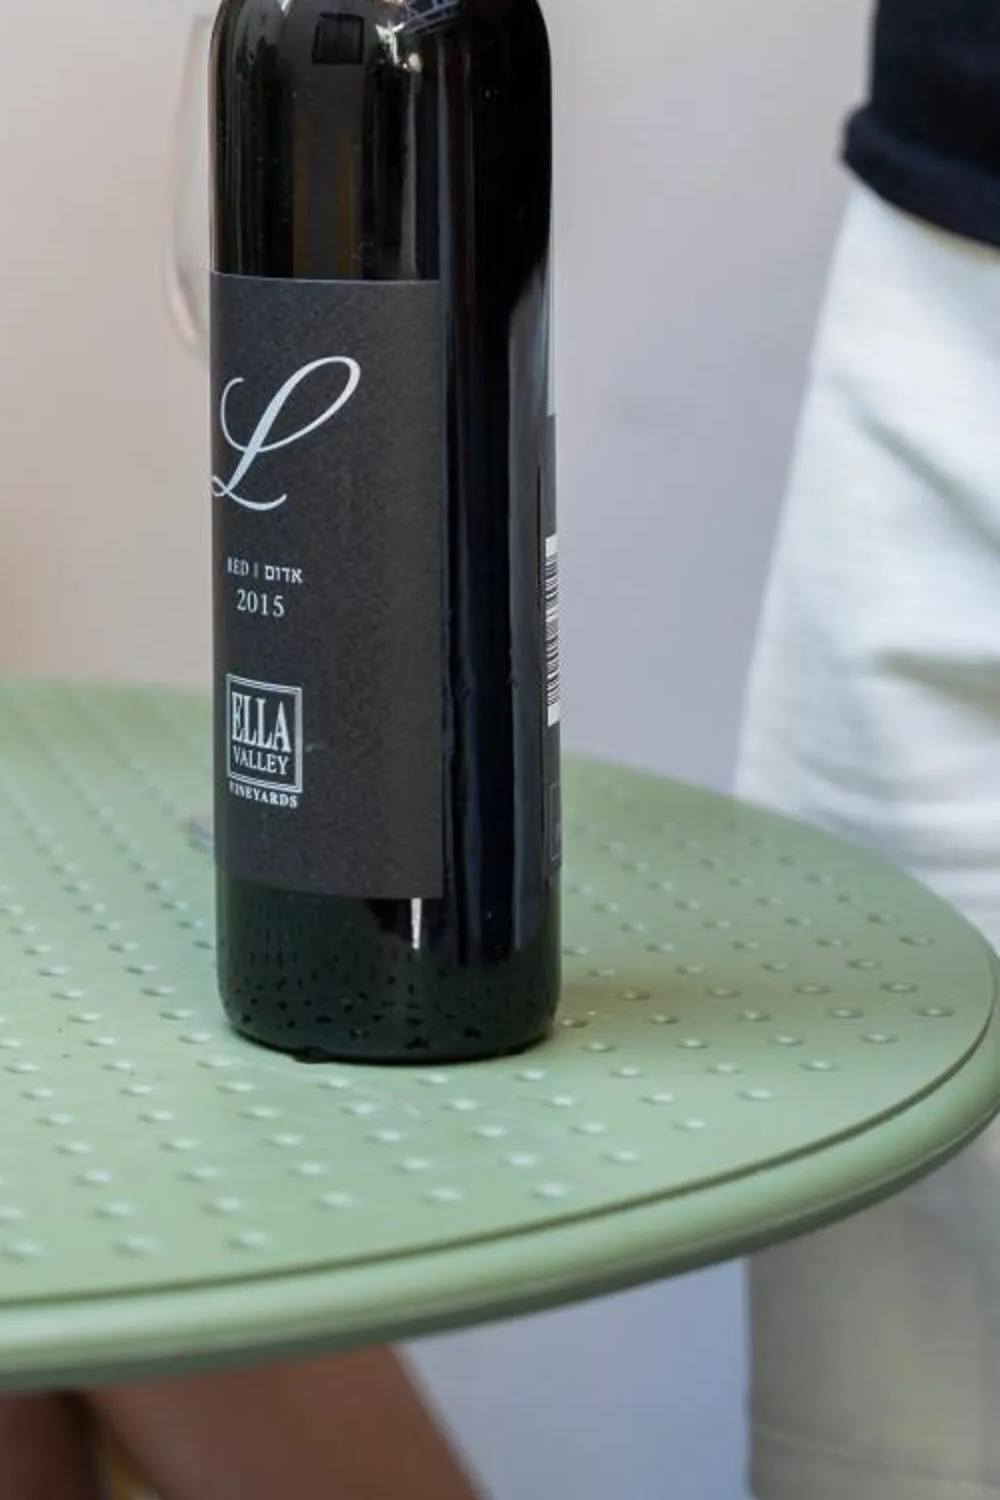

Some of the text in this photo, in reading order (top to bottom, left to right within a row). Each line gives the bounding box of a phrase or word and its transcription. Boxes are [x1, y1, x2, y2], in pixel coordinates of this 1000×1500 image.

[264, 564, 303, 584] אדום
[236, 588, 285, 617] 2015
[231, 691, 292, 753] ELLA
[232, 745, 290, 776] VALLEY
[229, 780, 299, 809] VINEYARDS
